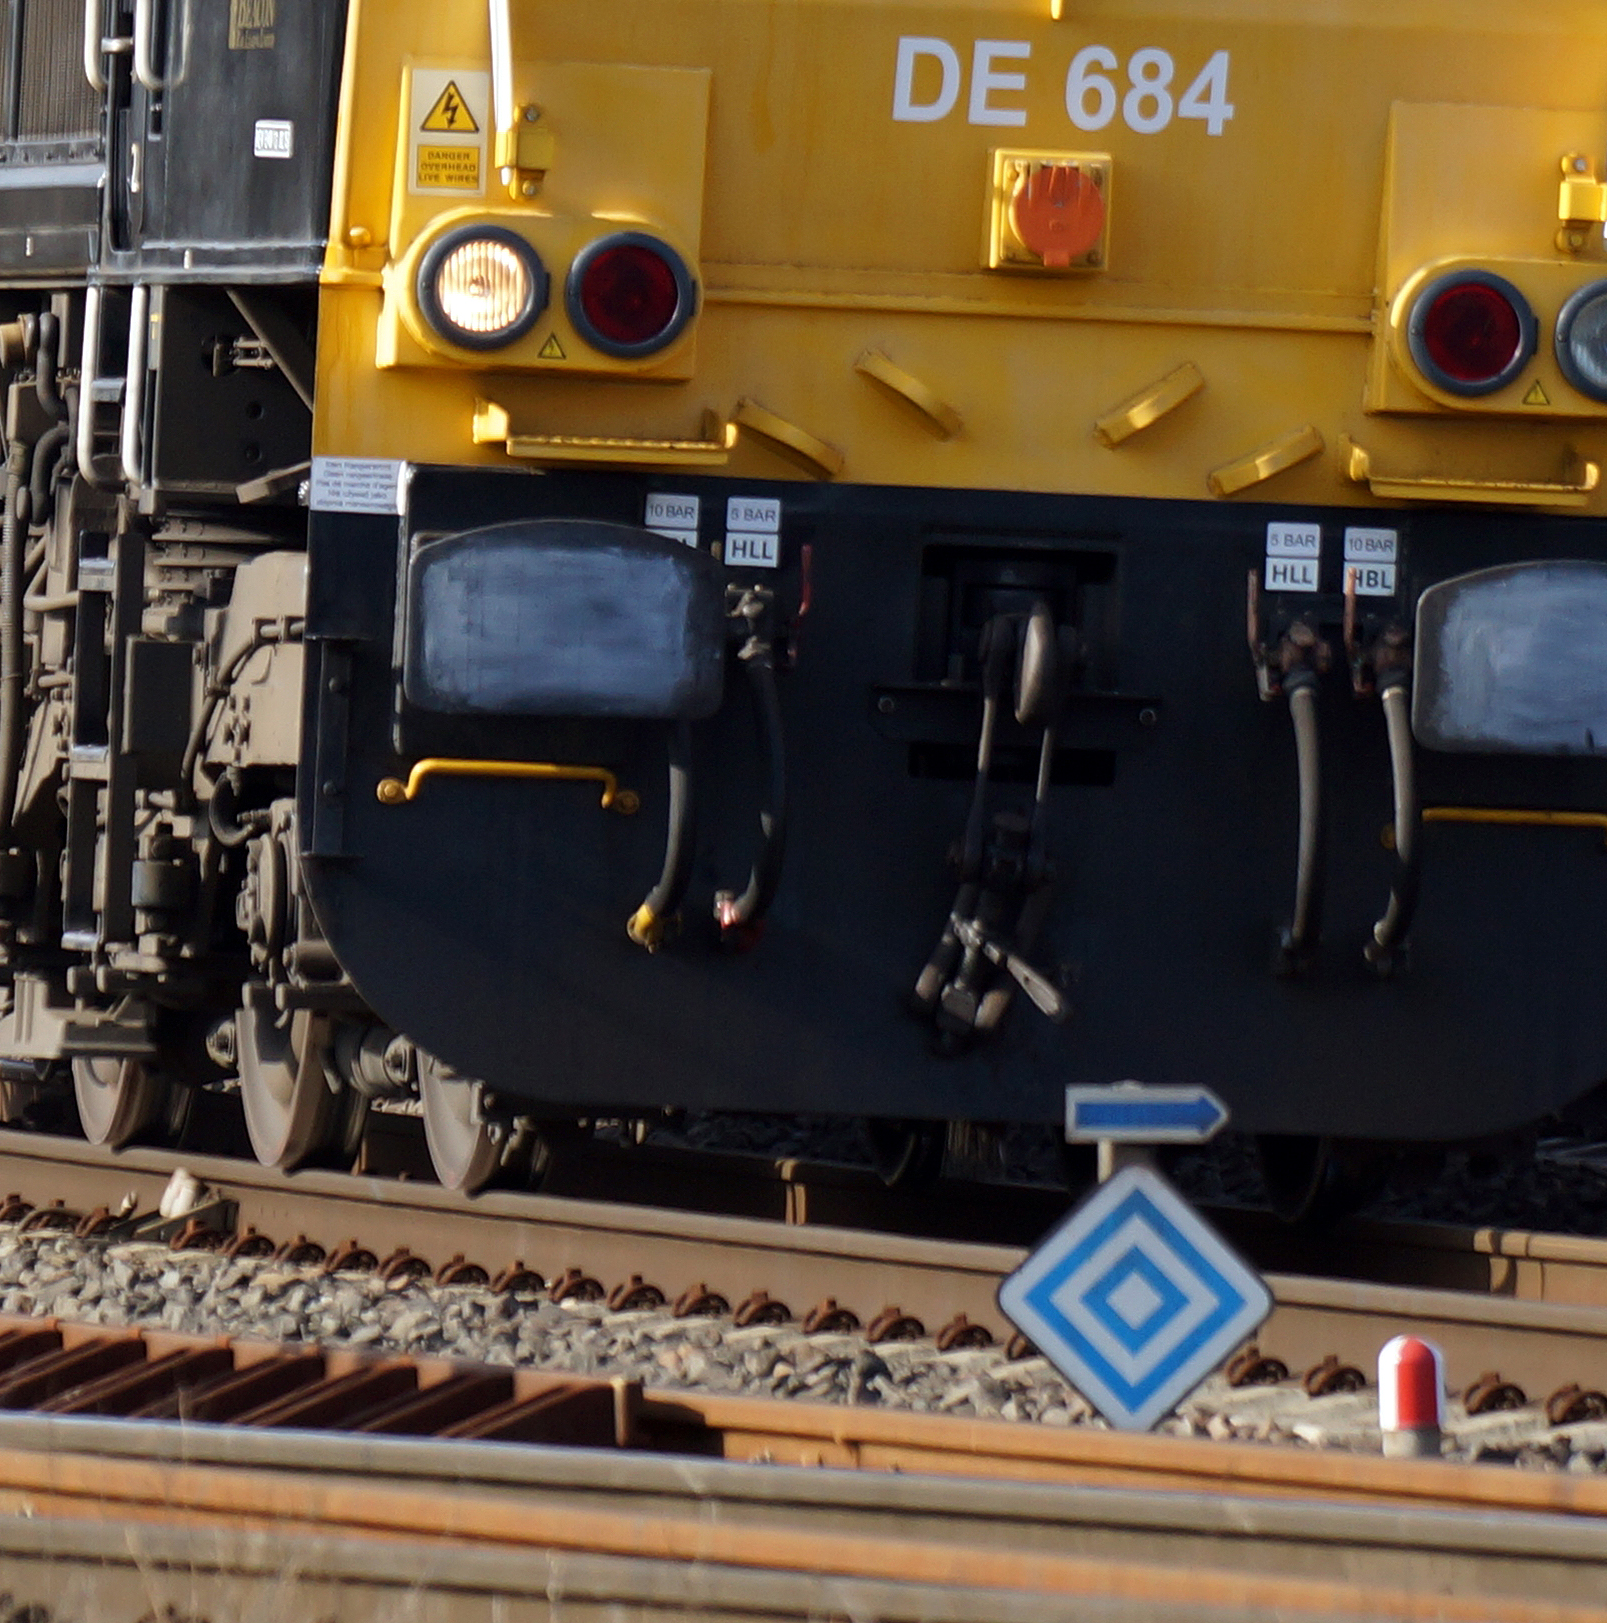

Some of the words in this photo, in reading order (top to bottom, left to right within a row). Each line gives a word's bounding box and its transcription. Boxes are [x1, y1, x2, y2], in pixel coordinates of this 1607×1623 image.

[892, 36, 1031, 127] DE
[1065, 43, 1235, 137] 684
[427, 151, 470, 161] DANGER
[420, 162, 476, 172] OVERHEAD
[418, 173, 440, 183] LIVE
[445, 174, 479, 184] WIRES
[649, 504, 664, 517] 10
[666, 505, 694, 519] BAR
[731, 508, 740, 520] 5
[744, 509, 776, 523] BAR
[1270, 533, 1279, 546] 5
[1284, 534, 1316, 548] BAR
[1349, 538, 1363, 551] 10
[1365, 540, 1393, 553] BAR
[732, 539, 773, 560] HLL
[1272, 564, 1313, 584] HLL
